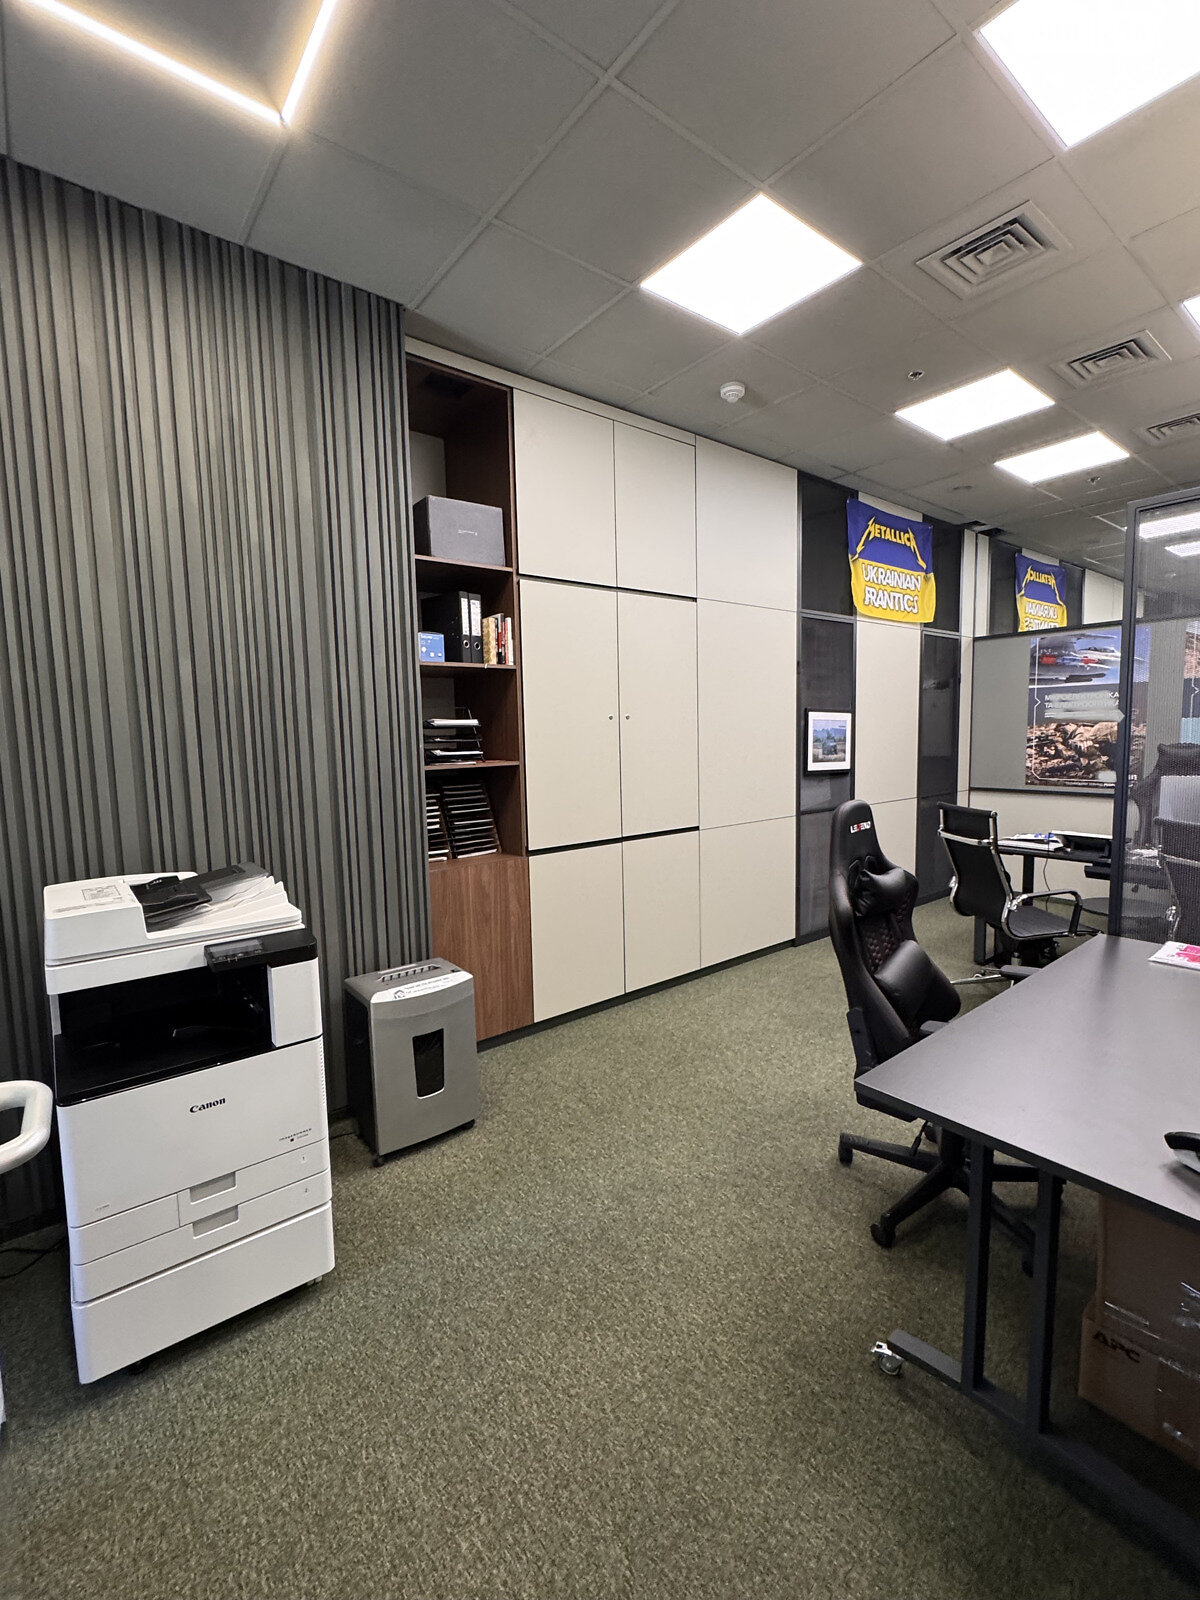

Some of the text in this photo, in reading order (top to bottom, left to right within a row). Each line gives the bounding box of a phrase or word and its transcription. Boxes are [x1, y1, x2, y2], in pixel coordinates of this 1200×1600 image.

[862, 562, 922, 592] UKRAINIAN
[864, 586, 919, 614] FRANTICS
[189, 1097, 226, 1114] Canon
[1093, 1331, 1140, 1363] APC
